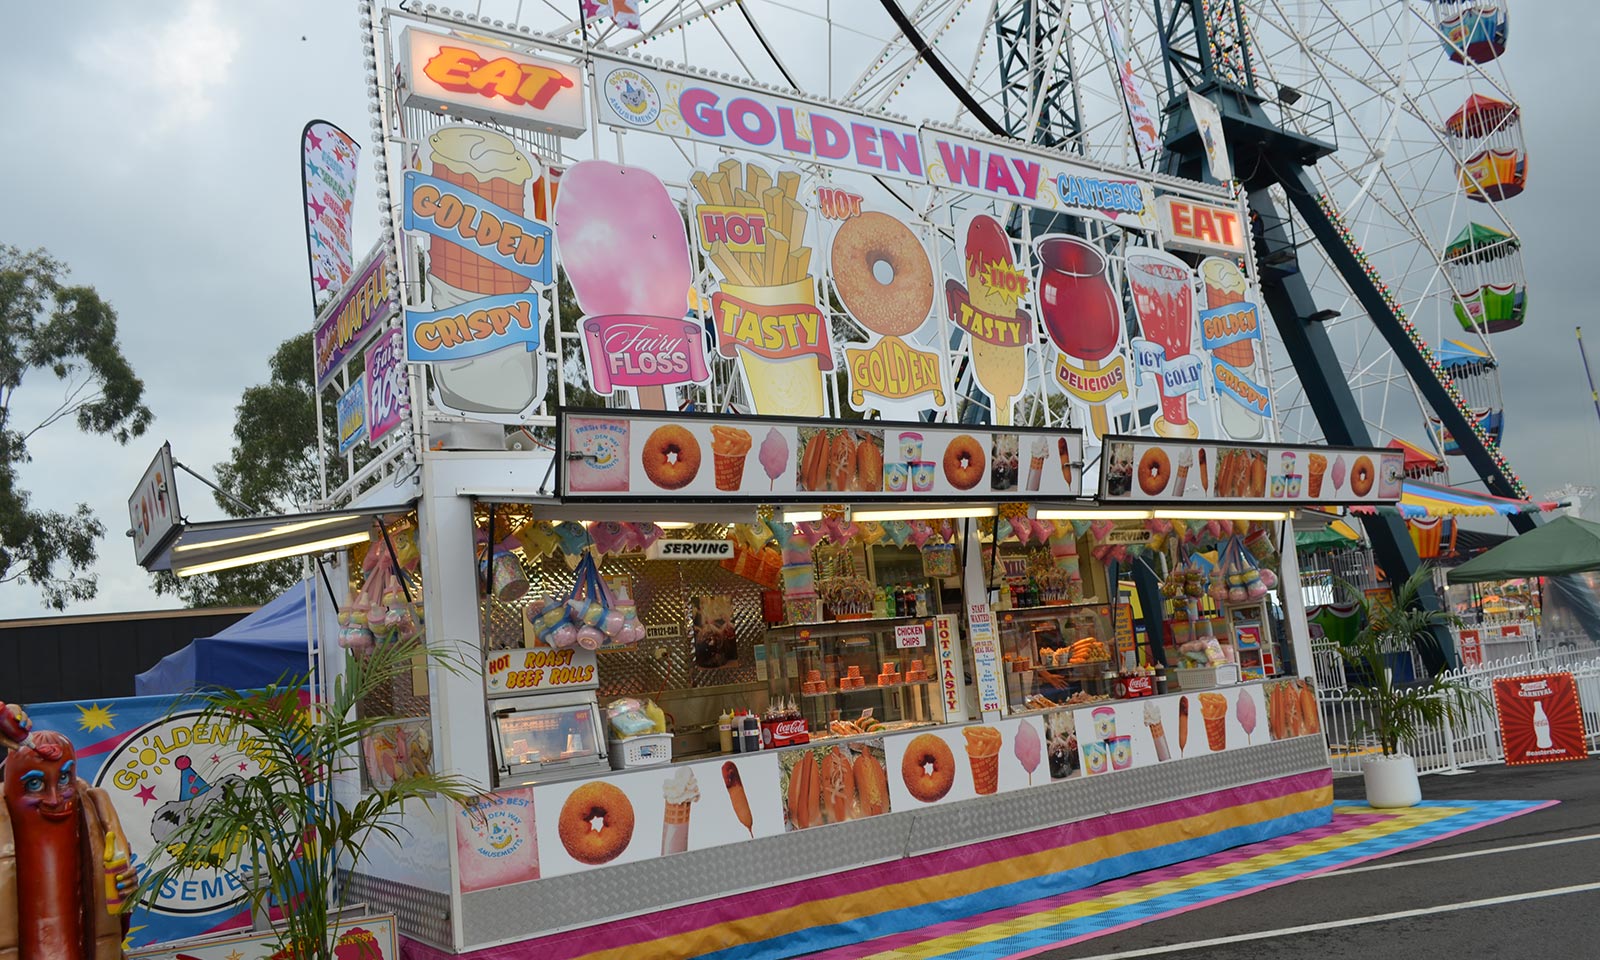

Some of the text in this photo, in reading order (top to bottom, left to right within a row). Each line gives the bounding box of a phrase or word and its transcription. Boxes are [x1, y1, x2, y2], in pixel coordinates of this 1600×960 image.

[423, 45, 574, 110] EAT
[610, 97, 657, 123] AMUSEMENTS
[678, 87, 1041, 200] GOLDEN WAY
[818, 187, 864, 221] HOT
[1056, 172, 1146, 215] CANTEENS
[412, 184, 545, 268] GOLDEN
[702, 214, 766, 245] HOT
[1169, 201, 1237, 246] EAT
[991, 267, 1030, 295] HOT
[413, 301, 533, 352] CRISPY
[719, 300, 820, 350] TASTY
[960, 302, 1021, 344] TASTY
[1203, 309, 1257, 340] GOLDEN
[603, 323, 683, 359] Fairy
[609, 352, 689, 375] FLOSS
[854, 342, 938, 394] GOLDEN
[1139, 351, 1161, 368] ICY
[1059, 365, 1123, 392] DELICIOUS
[1165, 365, 1199, 387] COLD
[1215, 364, 1268, 412] CRISPY
[662, 543, 729, 555] SERVING
[1109, 531, 1150, 541] SERVING
[896, 626, 923, 637] CHICKEN
[970, 614, 990, 623] WANTED
[902, 637, 920, 647] CHIPS
[938, 620, 950, 649] HOT
[489, 654, 510, 675] HOT
[524, 649, 576, 669] ROAST
[506, 664, 595, 689] BEEF ROLLS
[943, 660, 957, 710] TASTY
[1518, 688, 1553, 697] CARNIVAL
[984, 703, 998, 711] $11
[776, 720, 805, 734] Coca-Cola
[113, 724, 231, 791] GOLDEN
[461, 802, 492, 817] FSH
[506, 797, 530, 807] BEST
[507, 812, 522, 824] WAY
[477, 838, 523, 858] AMUSEMENTS
